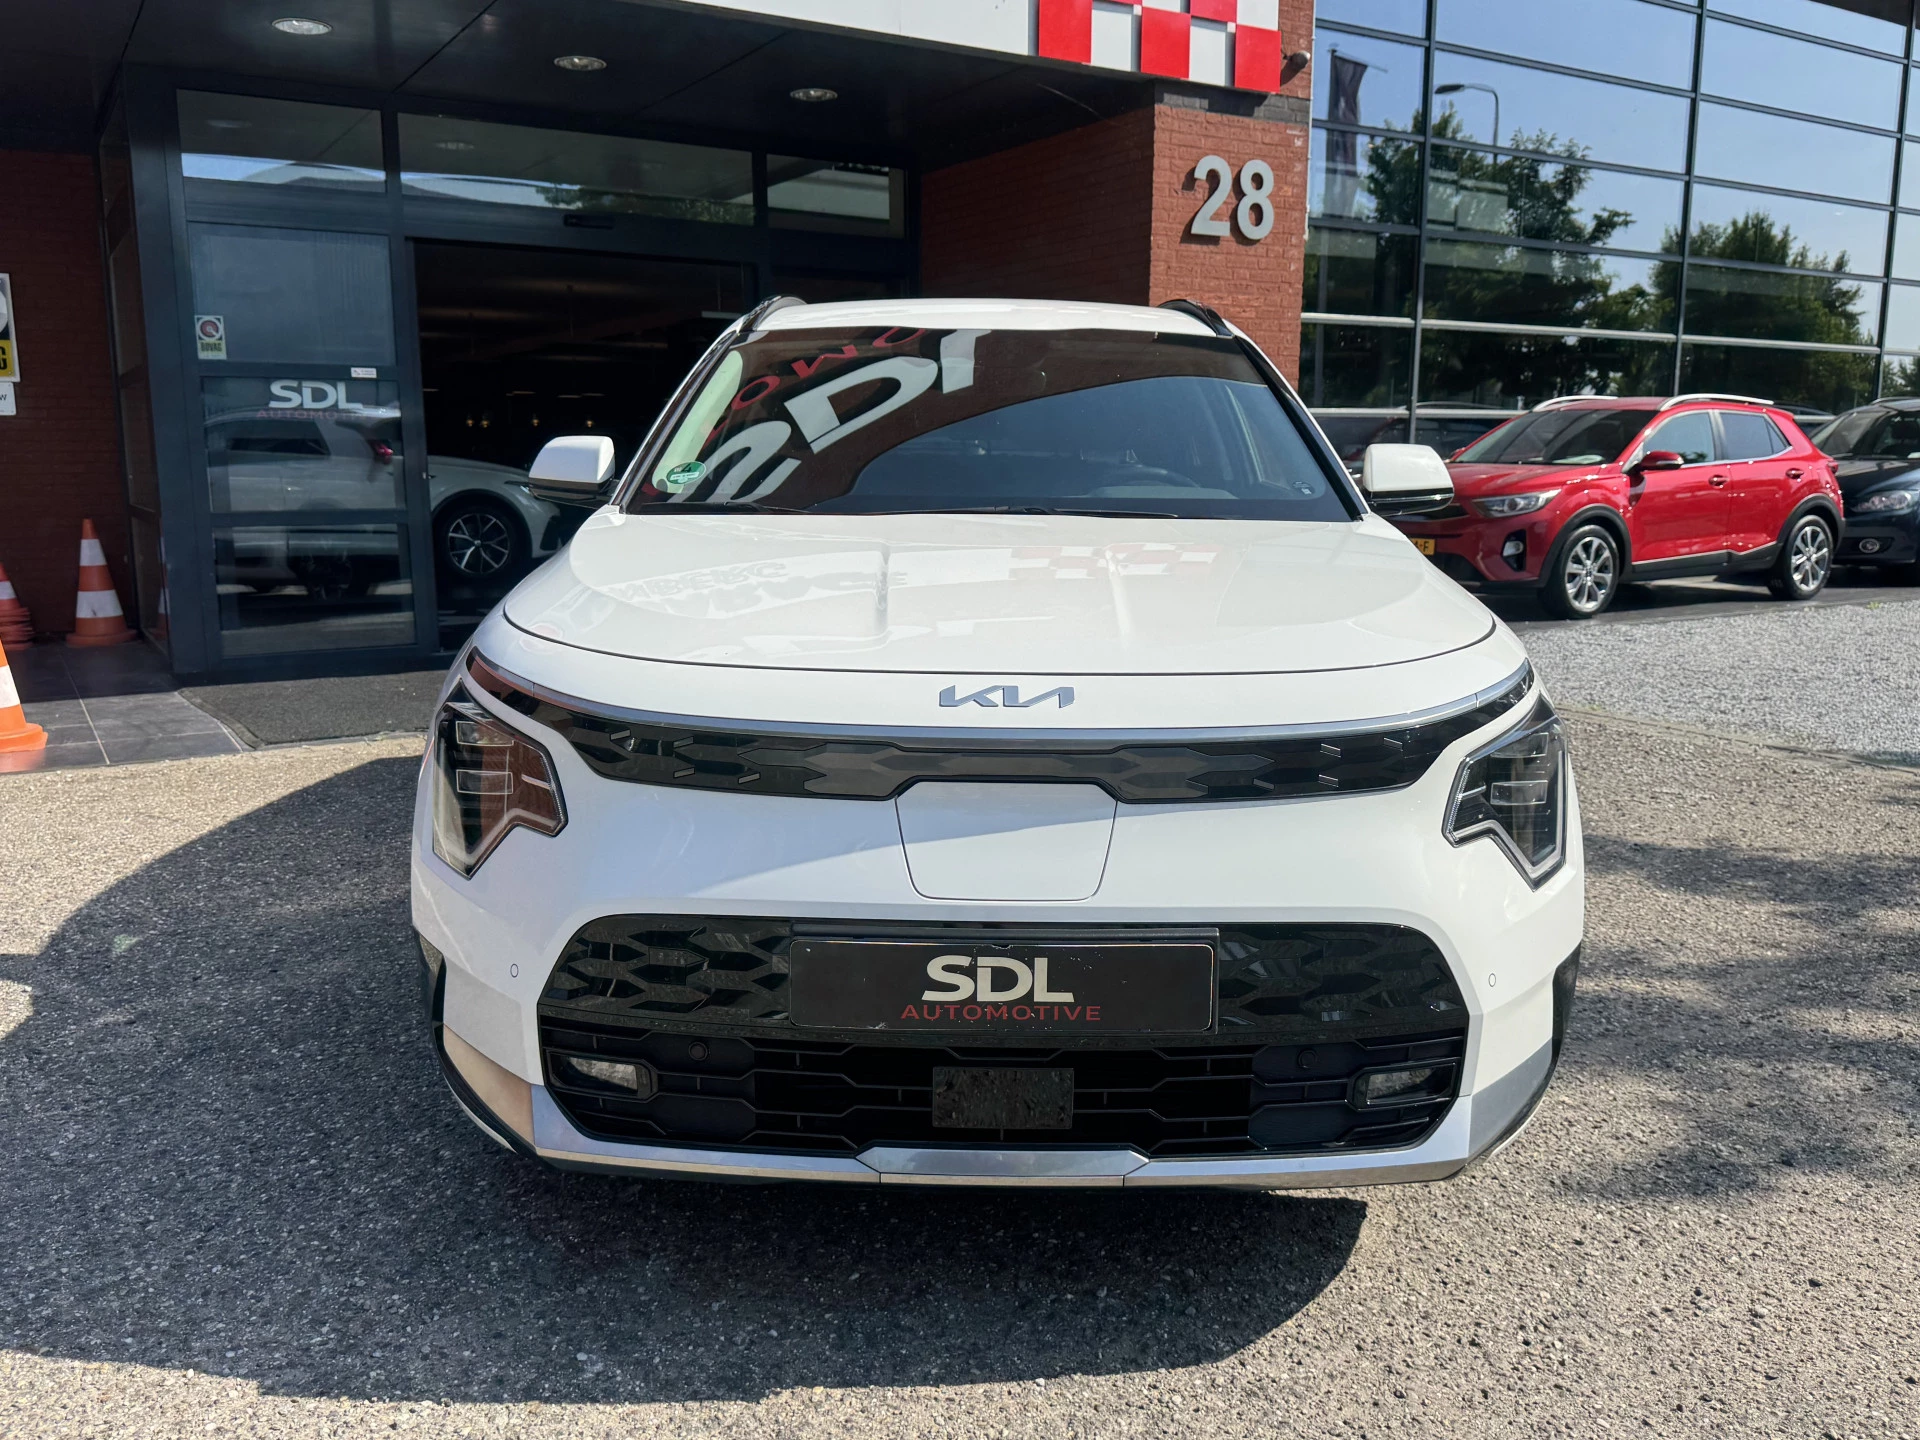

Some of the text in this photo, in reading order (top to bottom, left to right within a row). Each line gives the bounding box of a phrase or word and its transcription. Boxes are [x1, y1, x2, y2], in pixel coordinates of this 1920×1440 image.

[1190, 154, 1275, 240] 28
[268, 379, 364, 410] SDL
[938, 684, 1076, 709] KIA
[921, 954, 1075, 1003] SDL
[901, 1004, 1101, 1021] AUTOMOTIVE
